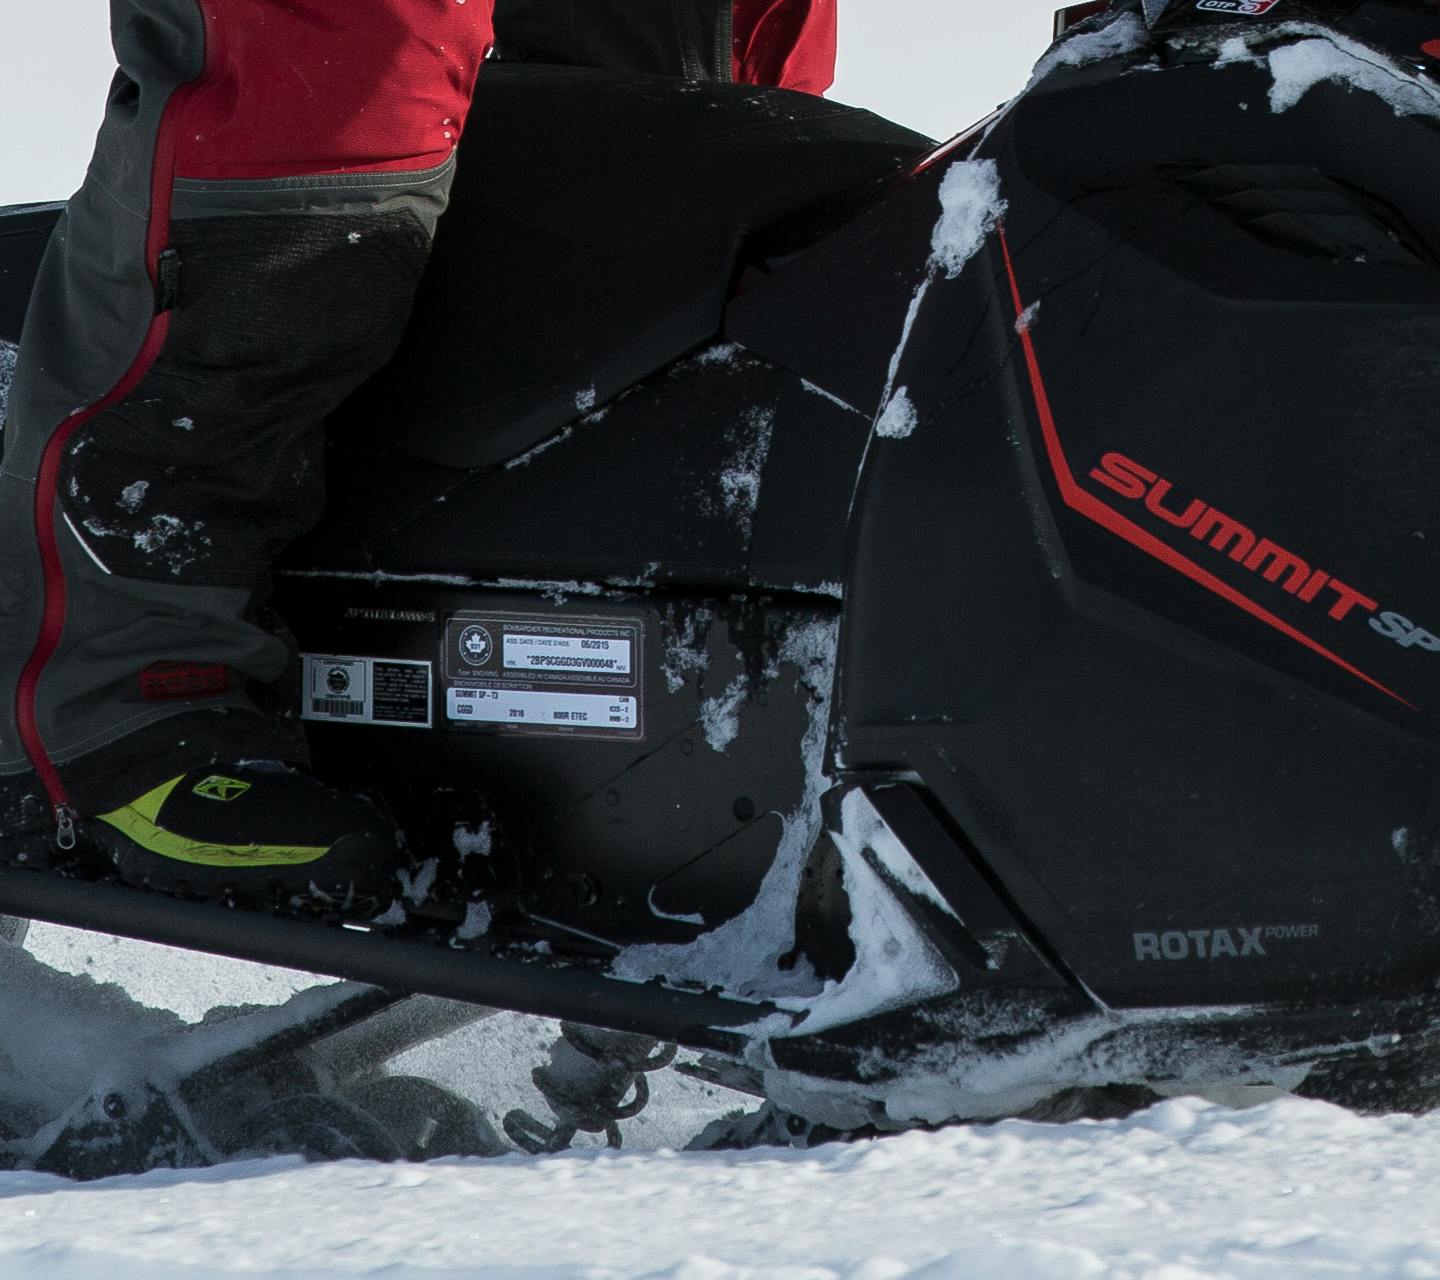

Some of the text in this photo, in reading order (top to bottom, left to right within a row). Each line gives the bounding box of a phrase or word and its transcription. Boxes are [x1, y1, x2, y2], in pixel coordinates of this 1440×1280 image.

[1205, 0, 1236, 9] OTP
[1089, 451, 1379, 622] SUMMIT
[1132, 924, 1320, 961] ROTAX POWER
